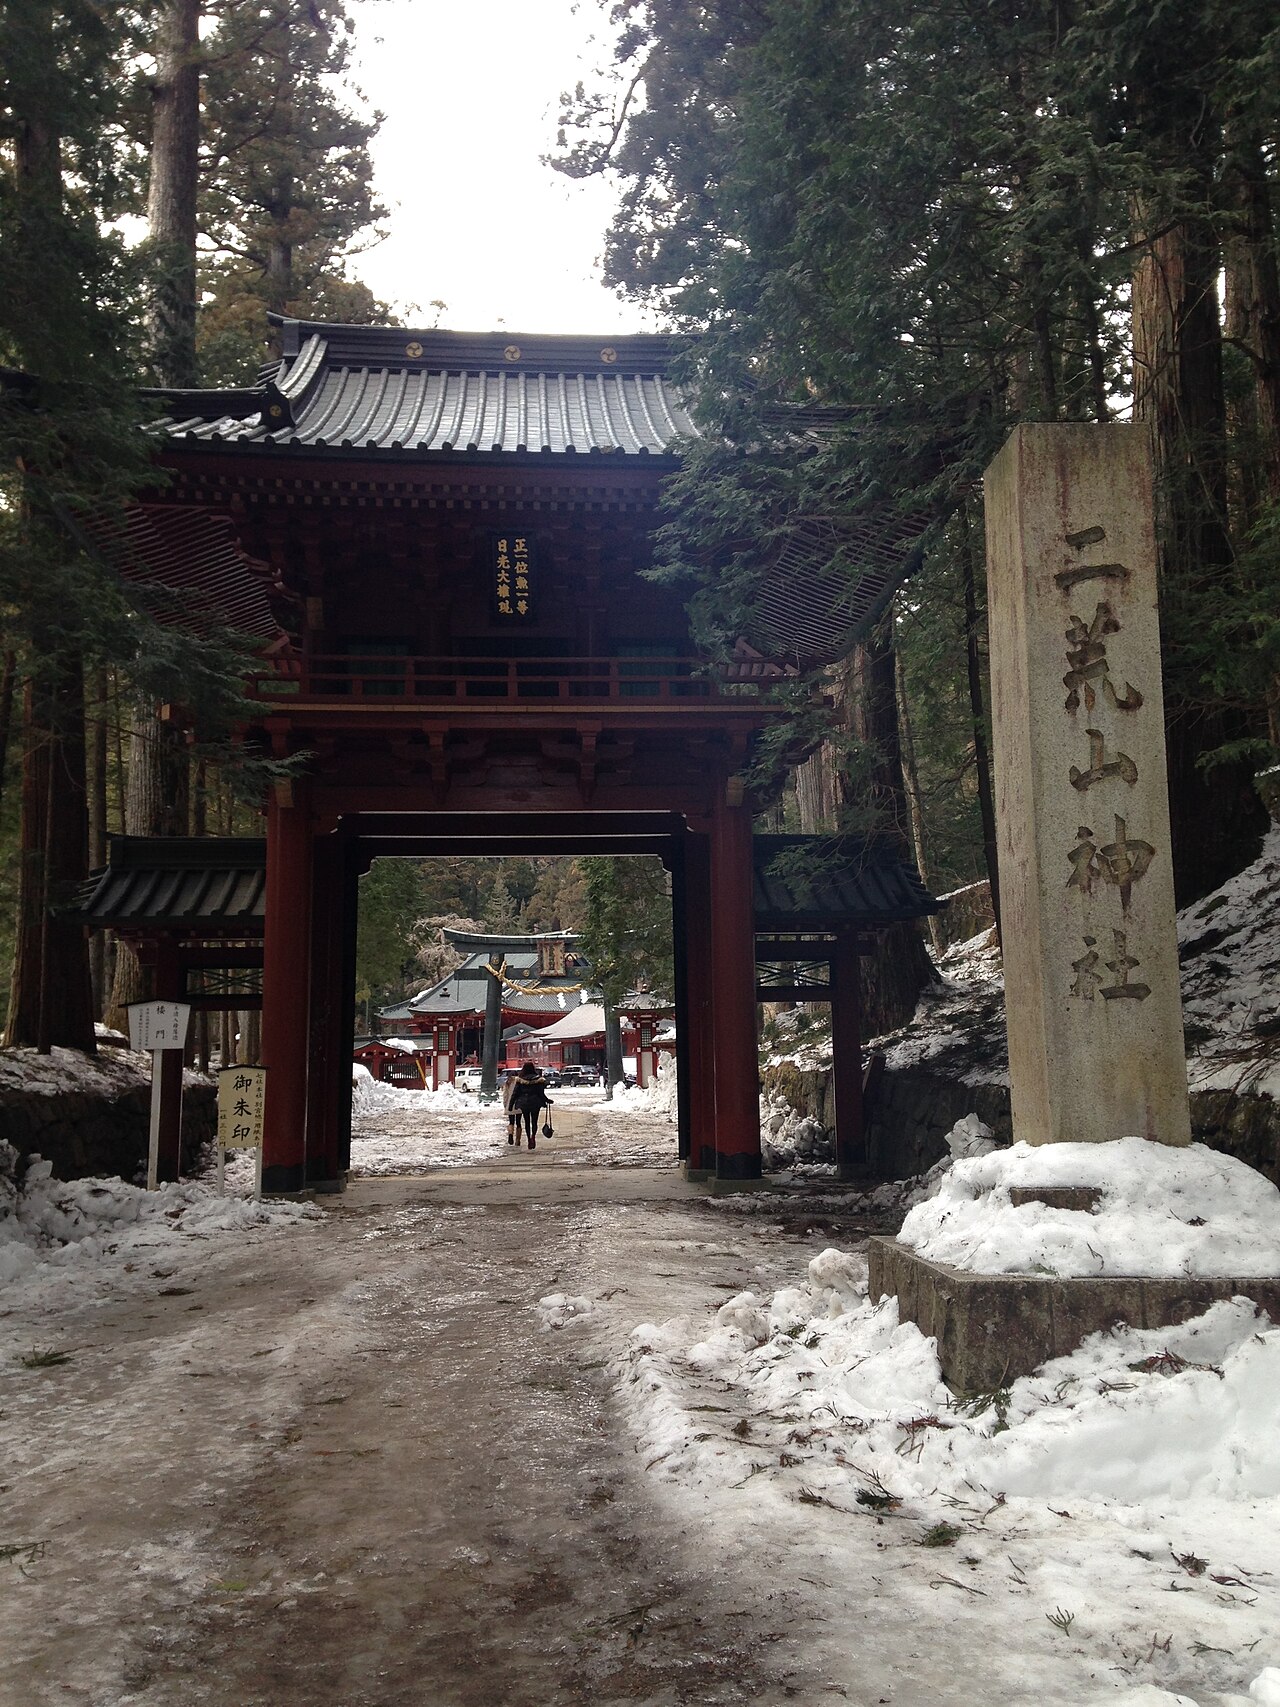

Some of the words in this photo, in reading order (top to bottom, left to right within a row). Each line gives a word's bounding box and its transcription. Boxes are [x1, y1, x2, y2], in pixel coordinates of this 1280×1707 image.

[1053, 524, 1157, 1001] 二荒山神社
[231, 1074, 253, 1142] 御朱印
